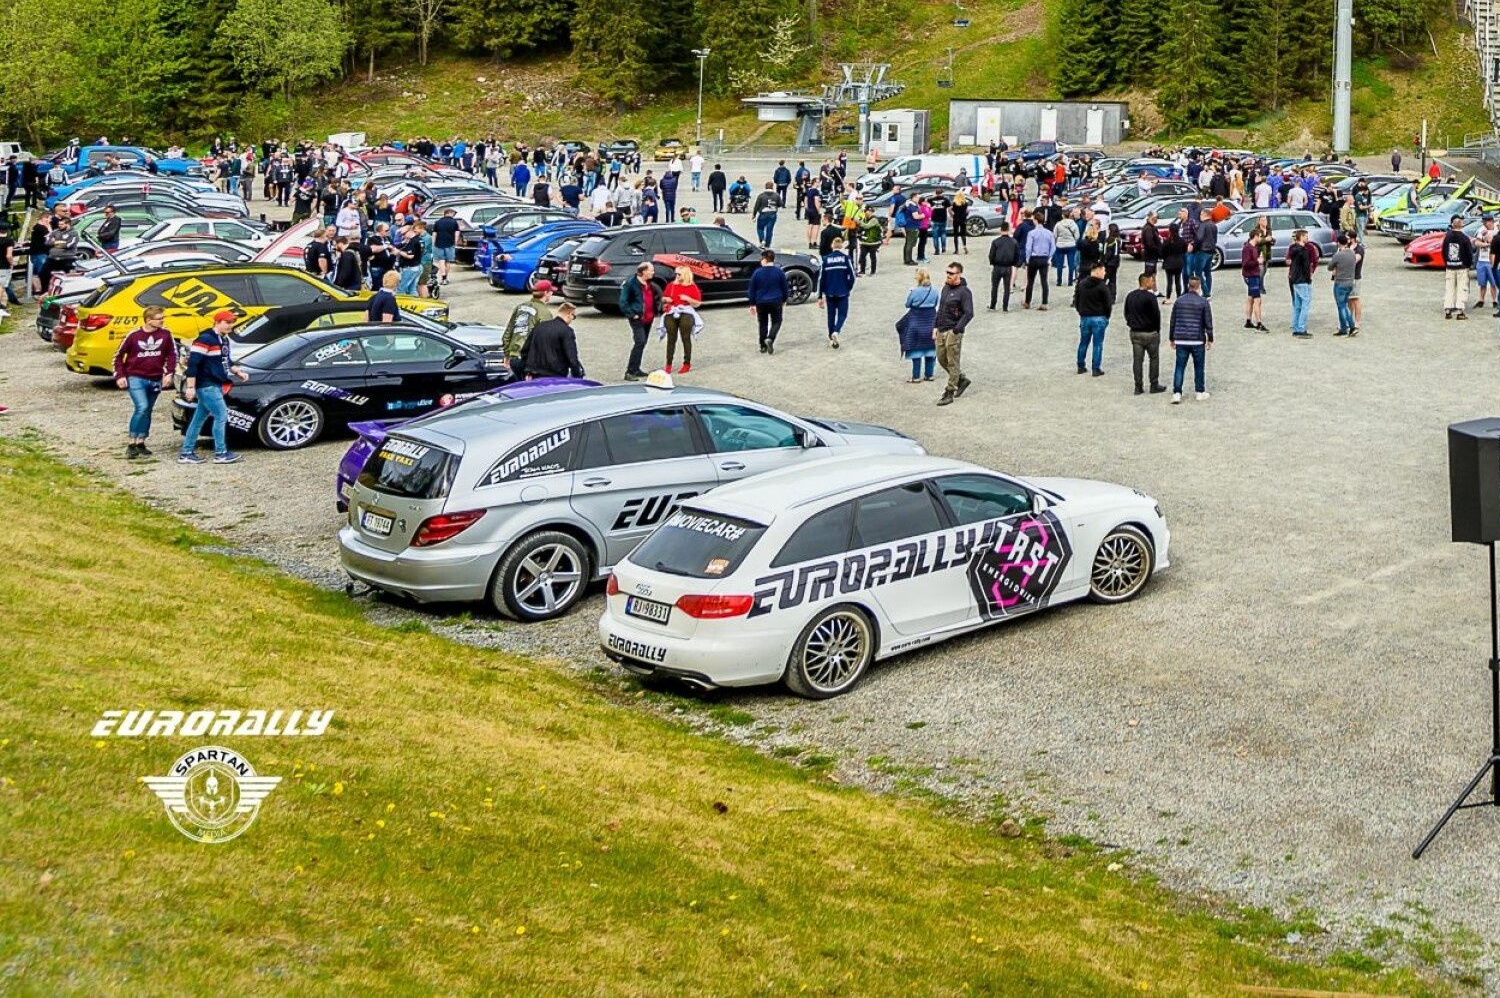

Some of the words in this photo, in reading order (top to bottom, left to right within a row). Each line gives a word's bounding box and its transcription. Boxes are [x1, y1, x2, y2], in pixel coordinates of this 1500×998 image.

[113, 316, 139, 326] #69
[137, 350, 161, 358] adidas
[490, 428, 571, 484] EURORALLY
[747, 528, 977, 619] EURORALLY
[608, 633, 667, 662] EURORALLY
